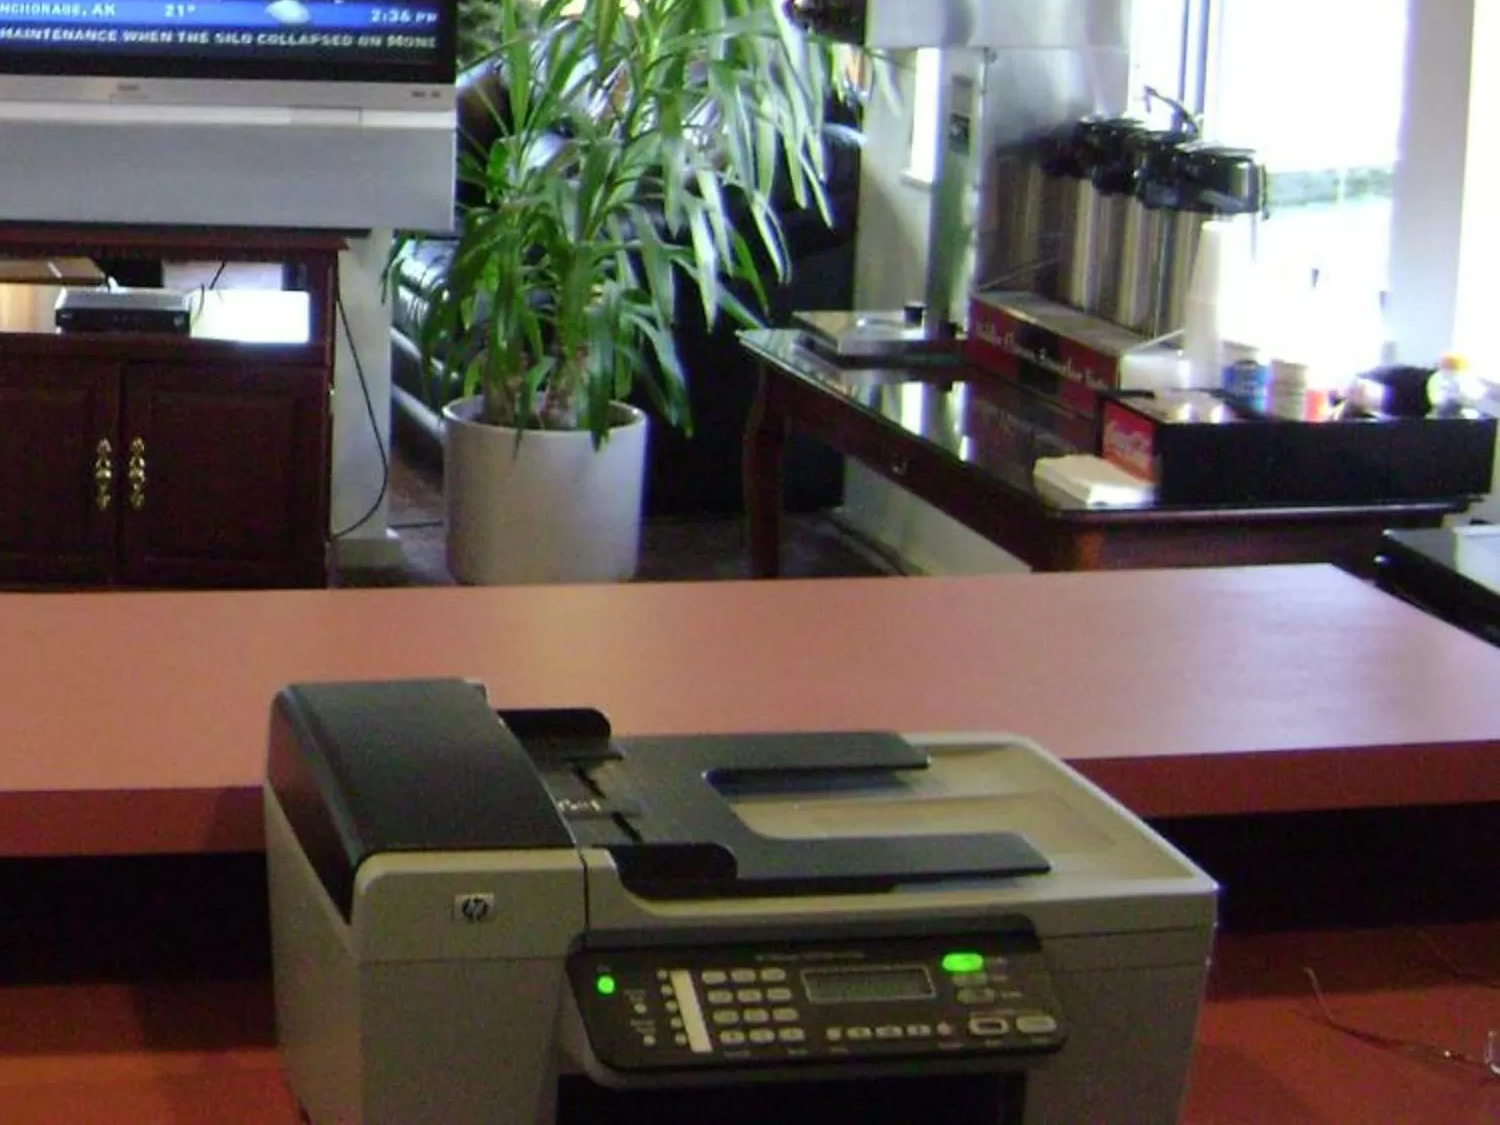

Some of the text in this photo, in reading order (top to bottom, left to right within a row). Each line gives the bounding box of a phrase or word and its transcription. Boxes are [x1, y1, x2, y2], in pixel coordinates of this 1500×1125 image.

[0, 26, 118, 43] MAINTENANCE
[123, 29, 173, 43] WHEN
[177, 30, 210, 44] THE
[257, 32, 353, 47] COLLAPSED
